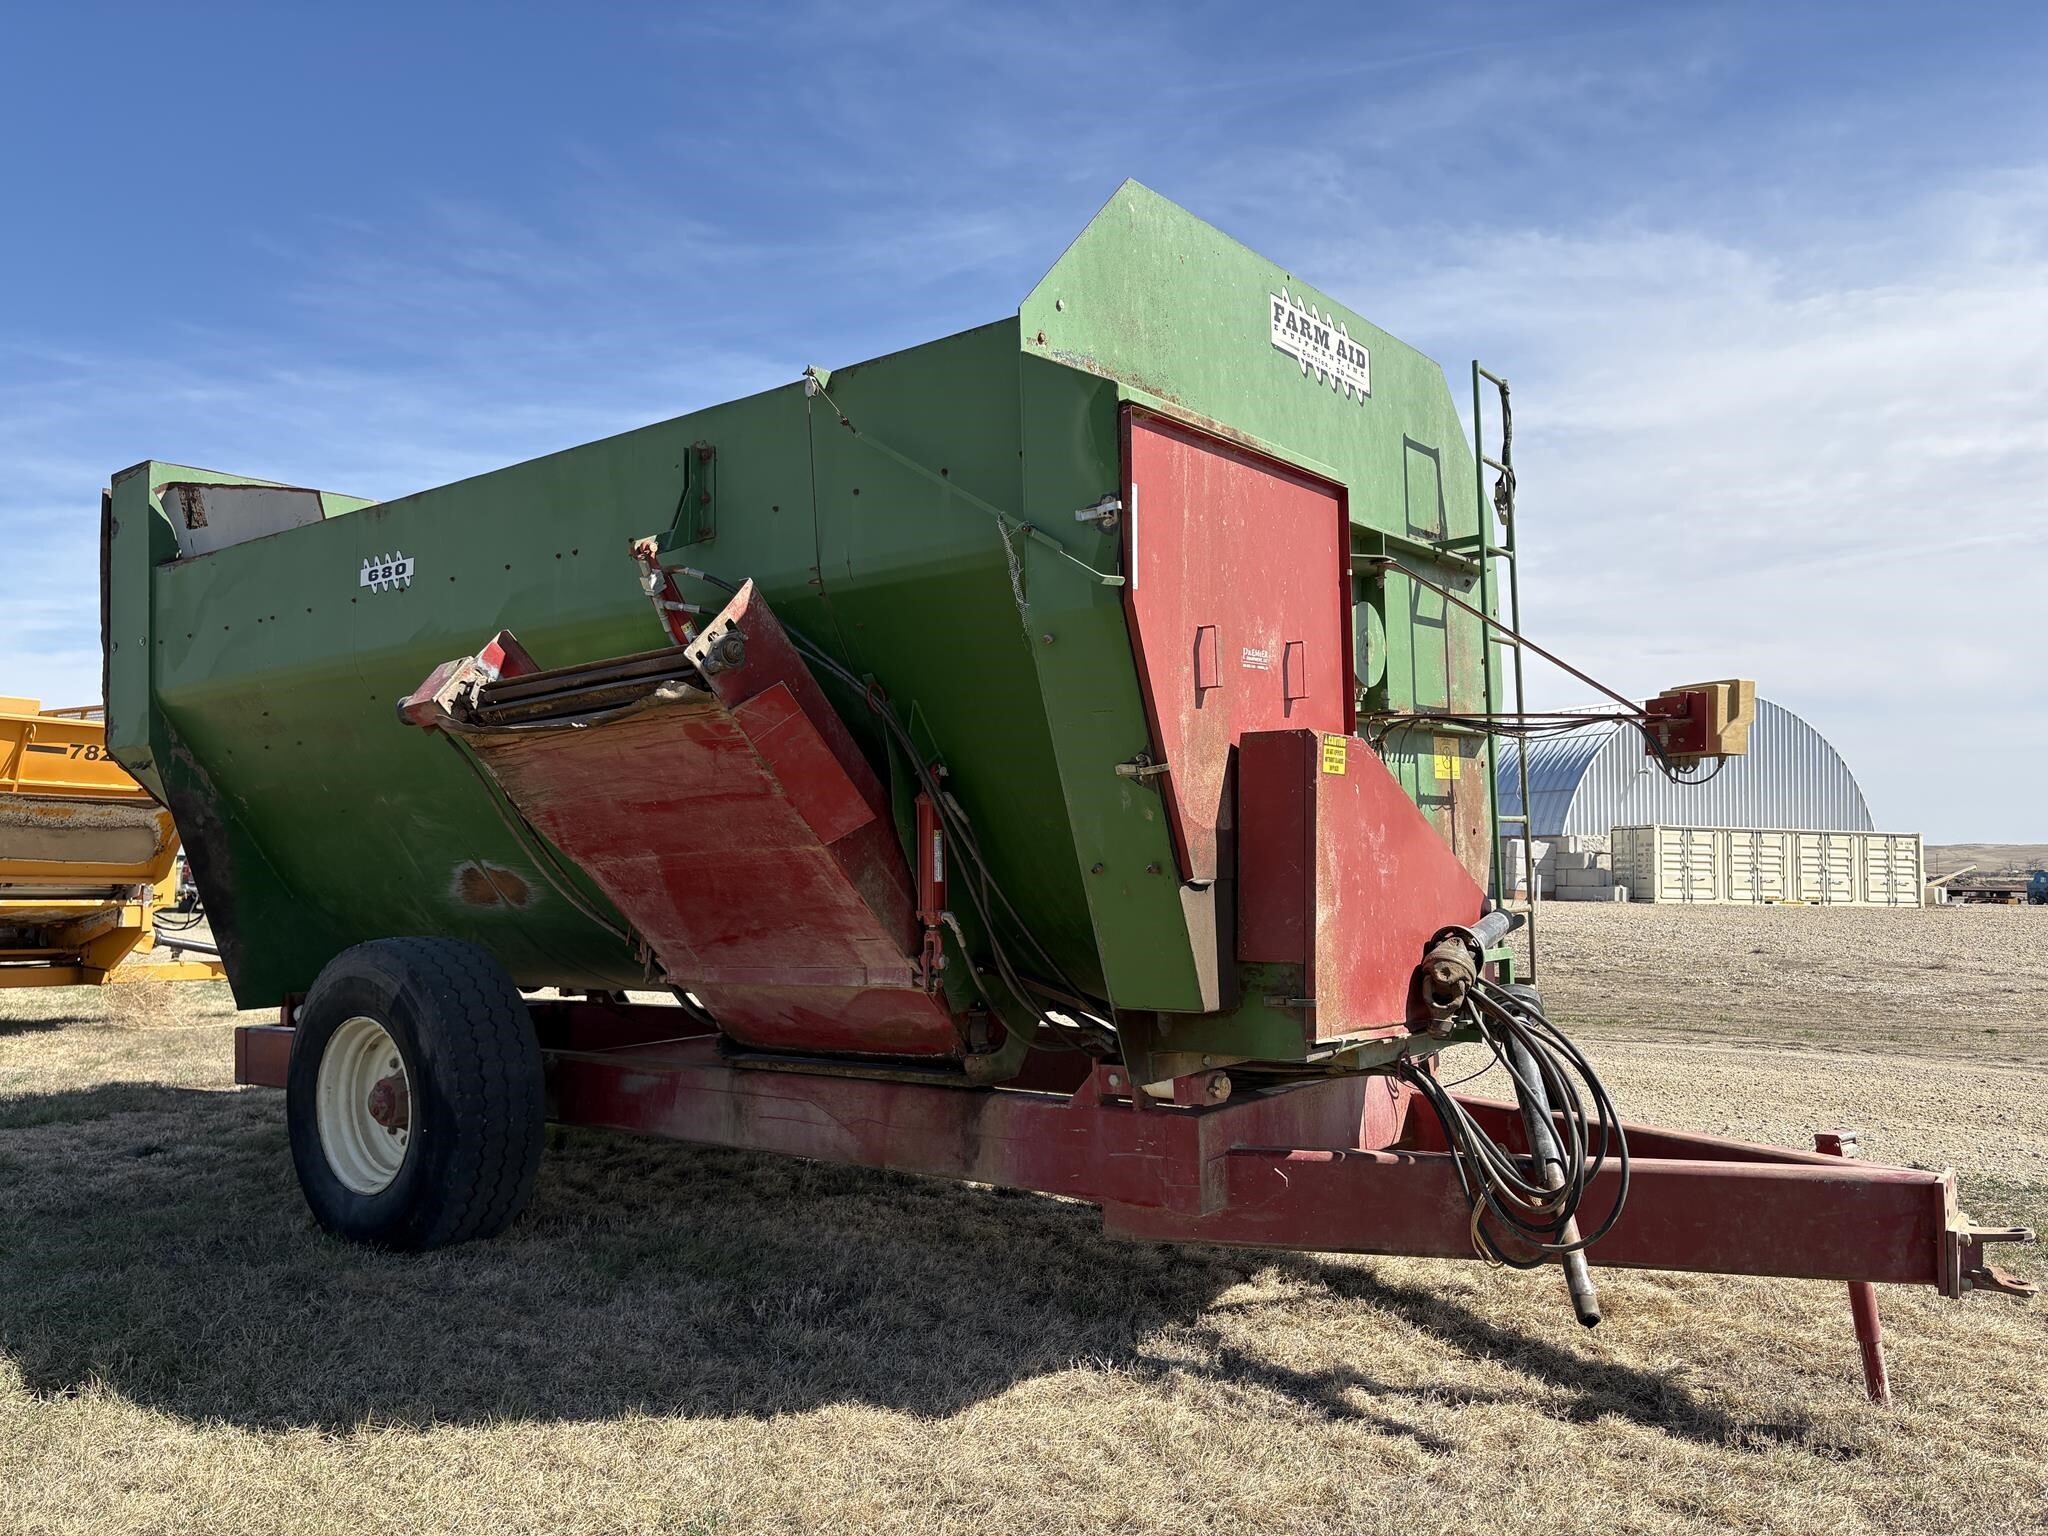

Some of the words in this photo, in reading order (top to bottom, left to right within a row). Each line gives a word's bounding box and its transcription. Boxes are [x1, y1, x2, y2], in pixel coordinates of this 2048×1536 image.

[1273, 301, 1330, 351] FARM
[1336, 339, 1366, 370] AID
[368, 562, 407, 582] 680
